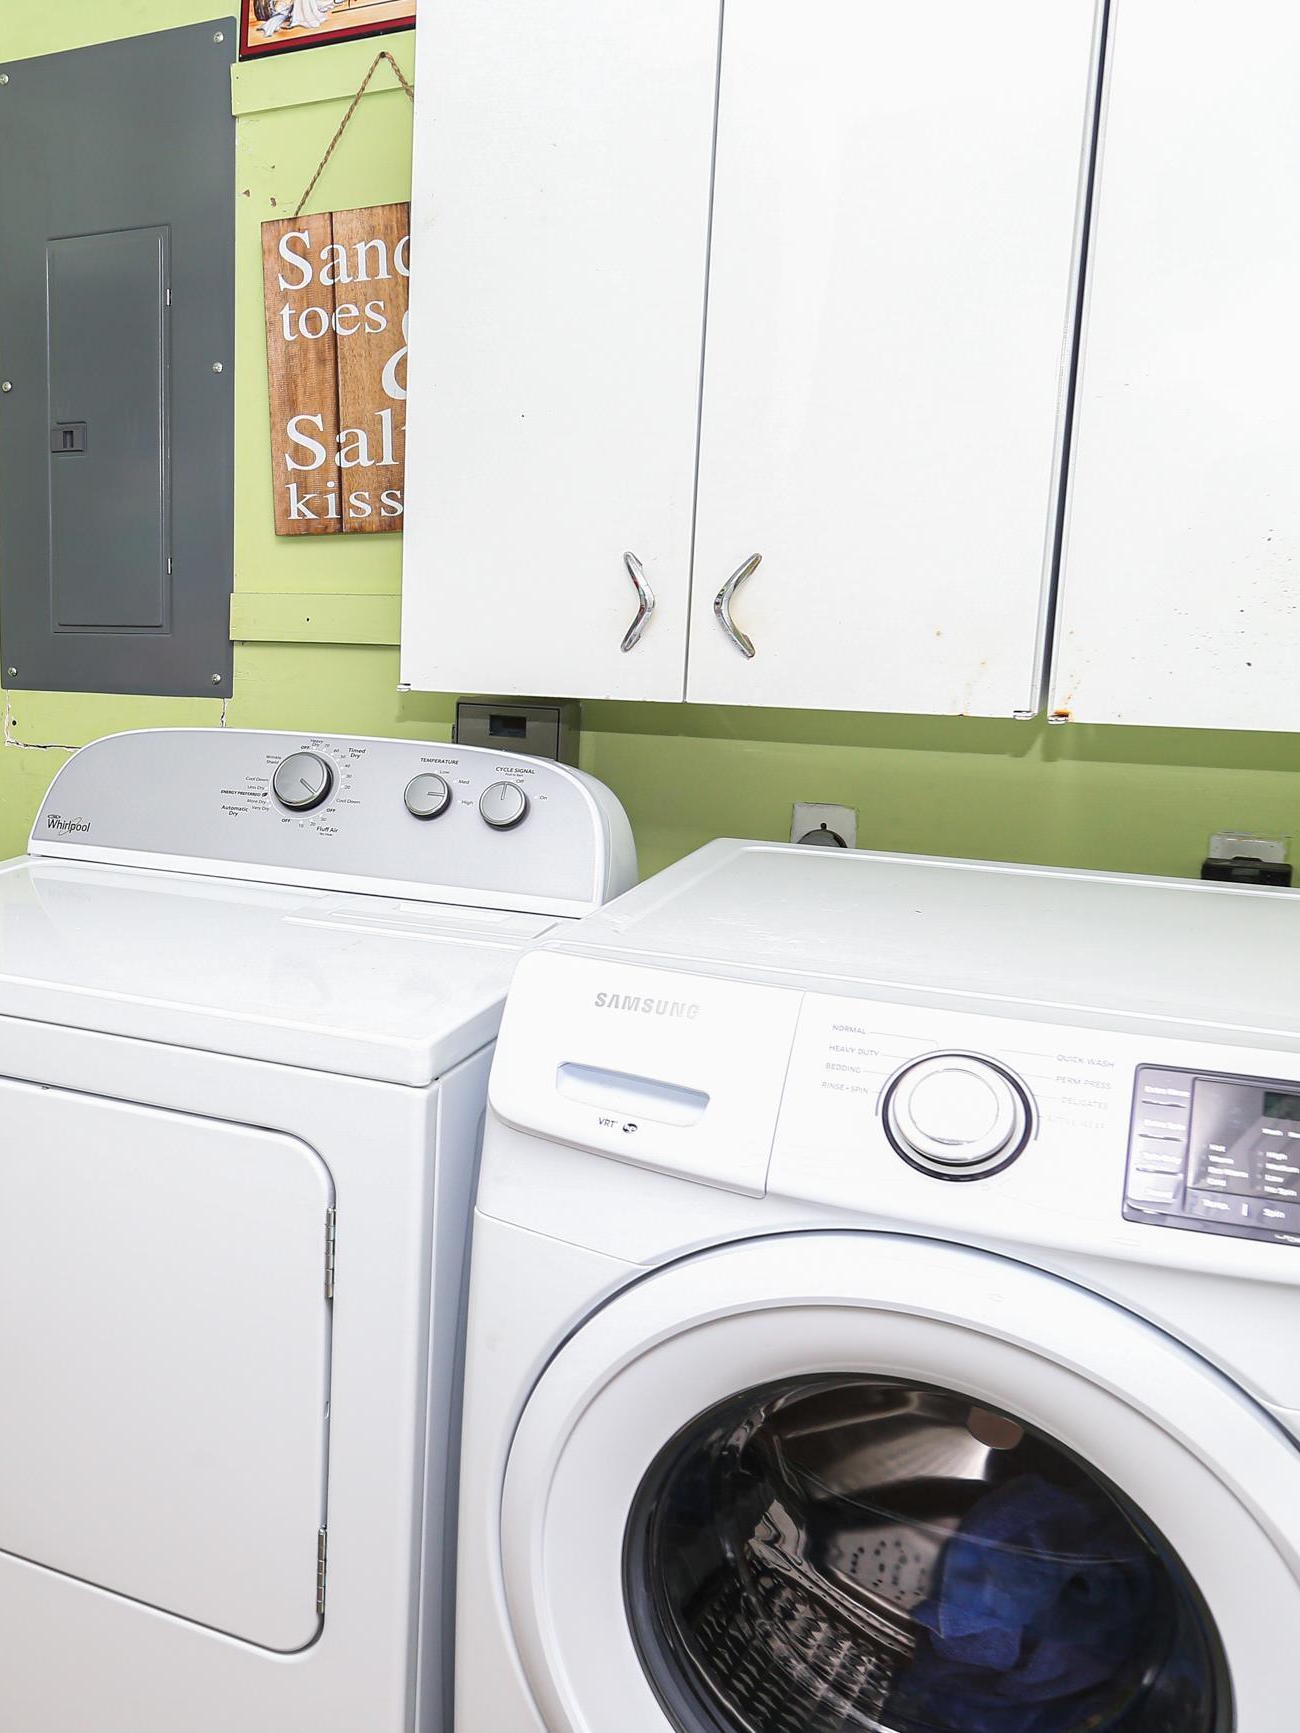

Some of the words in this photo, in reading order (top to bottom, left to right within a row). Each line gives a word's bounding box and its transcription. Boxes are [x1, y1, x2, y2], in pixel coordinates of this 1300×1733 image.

[279, 301, 387, 341] toes
[285, 408, 407, 471] Sal
[420, 757, 459, 766] TEMPERATURE
[514, 767, 536, 775] SIGNAL
[221, 804, 248, 812] Automatic
[47, 818, 91, 834] Whirlpool
[594, 991, 701, 1020] SAMSUNG
[832, 1023, 866, 1035] NORMAL
[828, 1045, 857, 1054] HEAVY
[857, 1047, 880, 1057] DUTY
[825, 1062, 862, 1074] BEDDING
